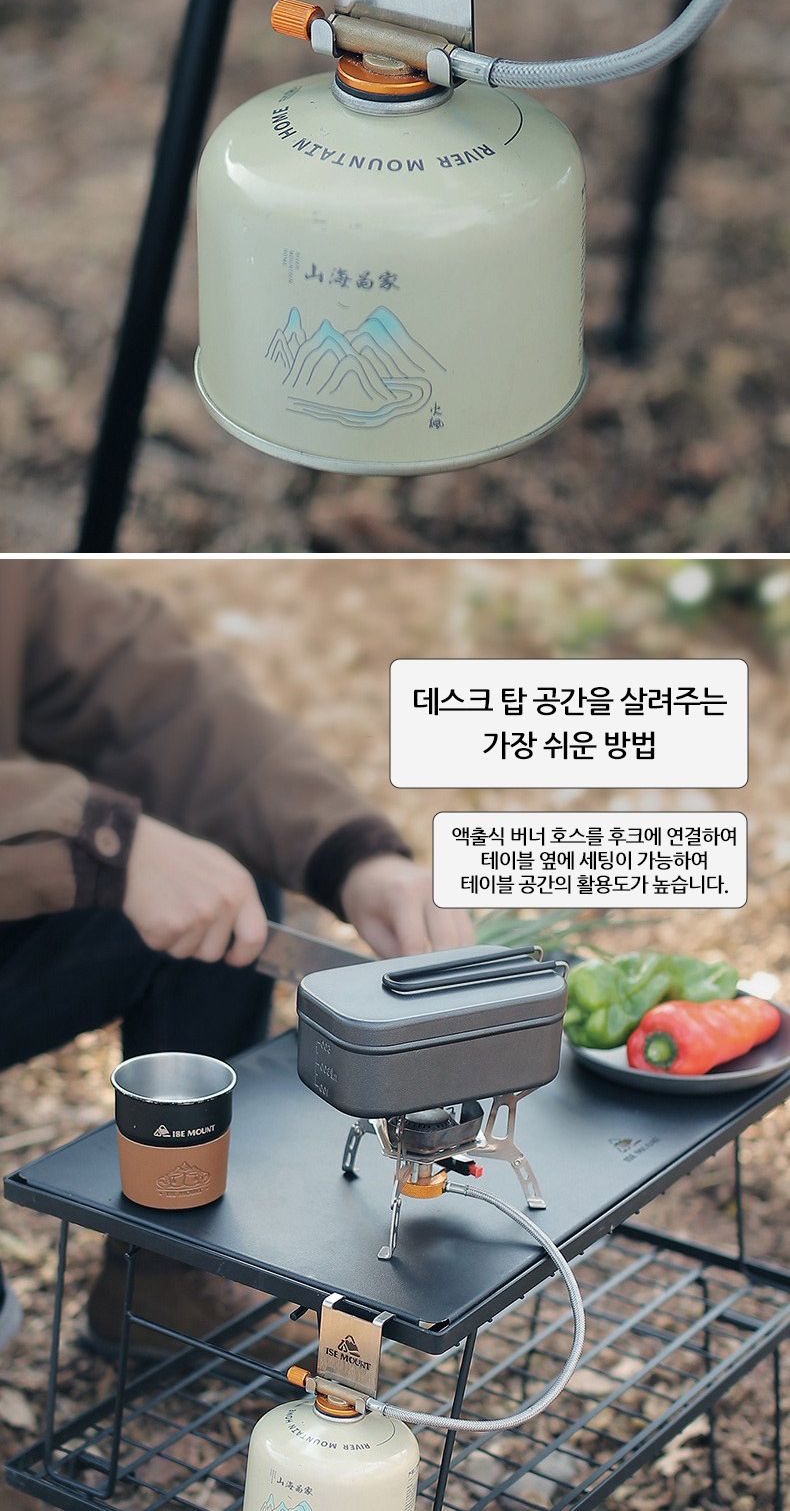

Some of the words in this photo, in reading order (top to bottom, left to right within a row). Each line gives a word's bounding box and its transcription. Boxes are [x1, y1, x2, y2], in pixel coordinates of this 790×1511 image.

[271, 105, 297, 140] HOME
[292, 137, 425, 172] MOUNTAIN
[436, 143, 496, 169] RIVER
[172, 1129, 186, 1138] ISE
[187, 1124, 216, 1137] MOUNT
[326, 1347, 339, 1358] ISE
[340, 1353, 371, 1370] MOUNT
[288, 1423, 338, 1450] MOUNTAIN
[343, 1442, 371, 1451] RIVER
